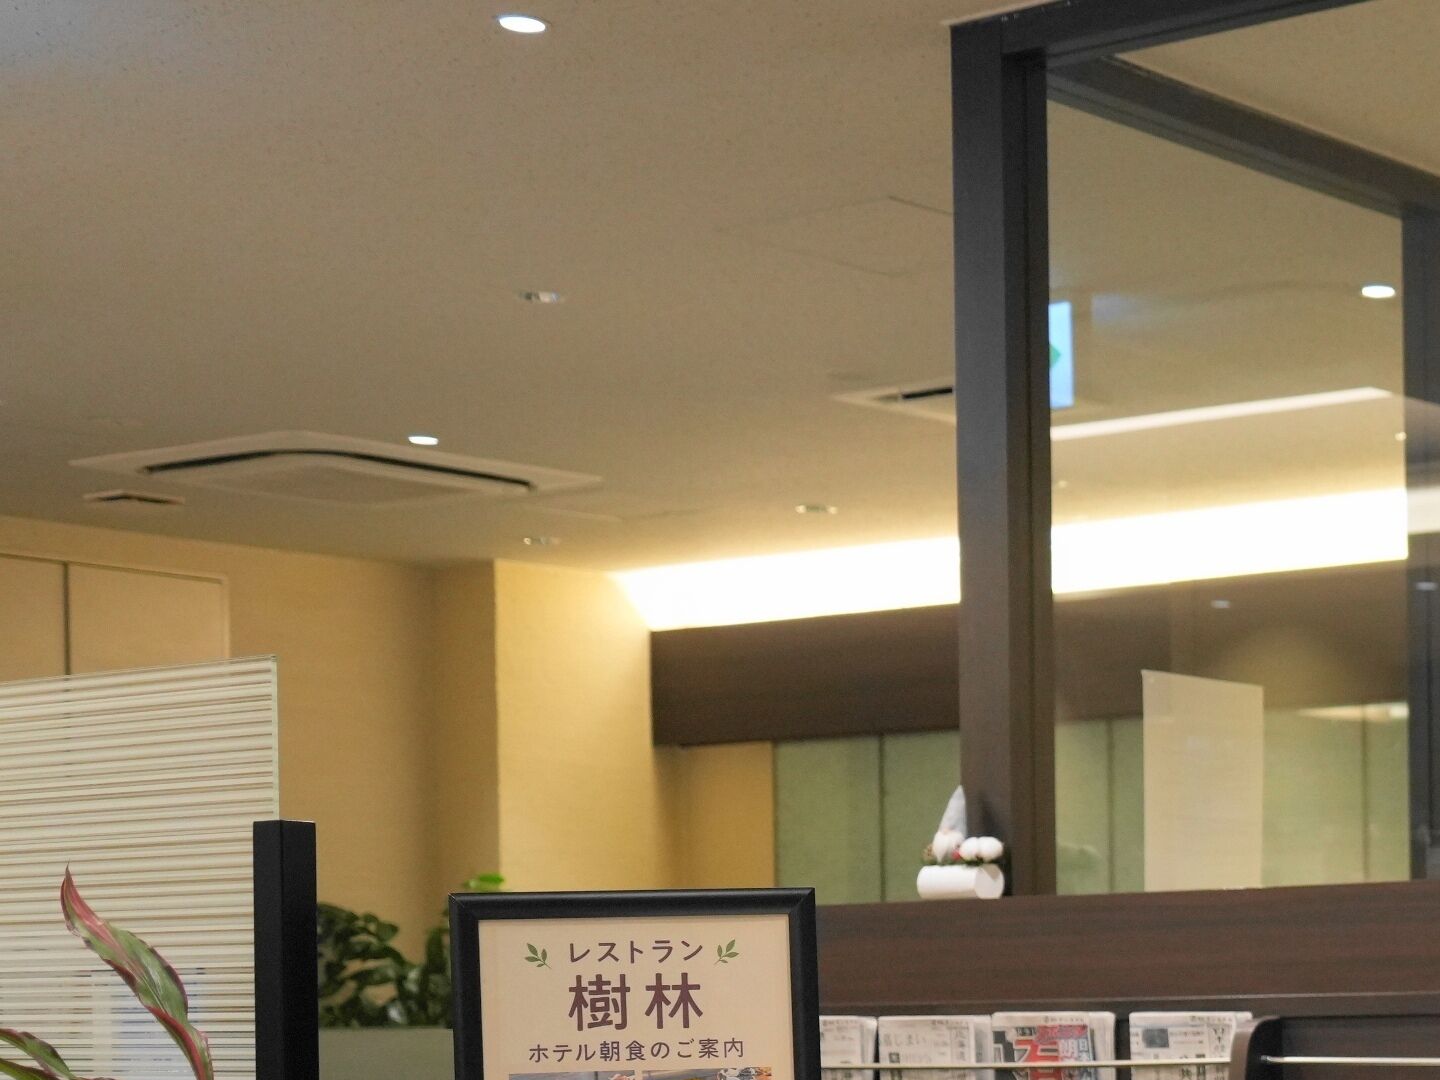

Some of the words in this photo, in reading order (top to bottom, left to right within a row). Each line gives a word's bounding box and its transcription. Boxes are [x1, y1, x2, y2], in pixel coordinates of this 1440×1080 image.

[569, 940, 703, 964] レストラン
[568, 972, 704, 1032] 樹林
[528, 1037, 744, 1063] ホテル朝食のご案内
